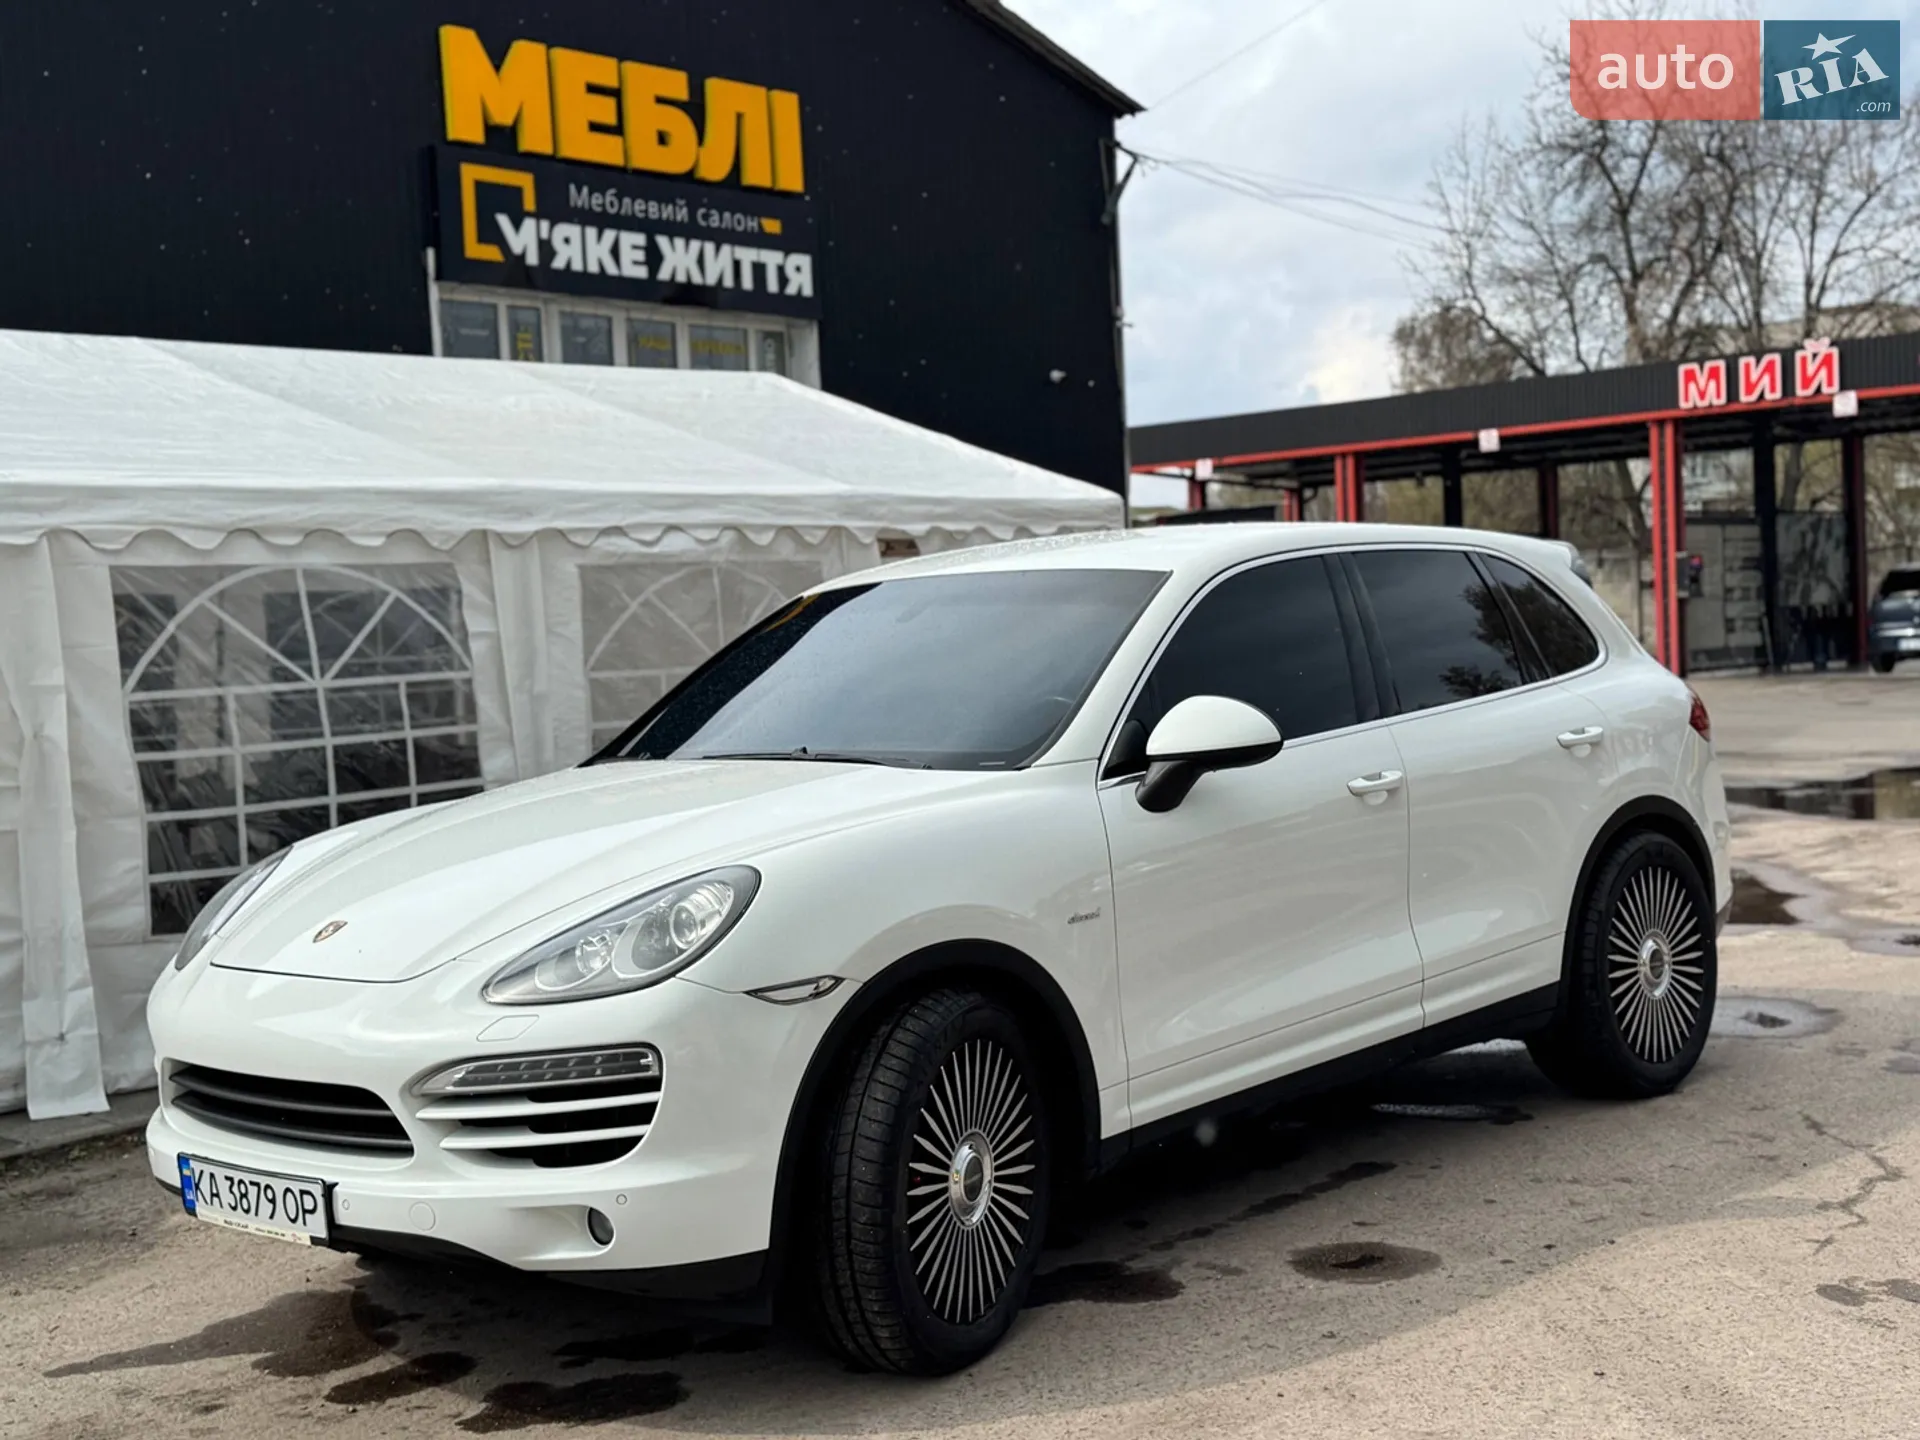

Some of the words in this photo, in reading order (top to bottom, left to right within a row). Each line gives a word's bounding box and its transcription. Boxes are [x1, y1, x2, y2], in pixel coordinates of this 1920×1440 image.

[438, 24, 805, 193] МЕБЛІ
[568, 182, 689, 224] Меблевий
[696, 207, 760, 233] салон
[654, 233, 815, 298] ЖИТТЯ
[1678, 336, 1840, 410] МИЙ
[190, 1166, 223, 1209] KA
[223, 1175, 277, 1221] 3879
[282, 1186, 318, 1227] OP
